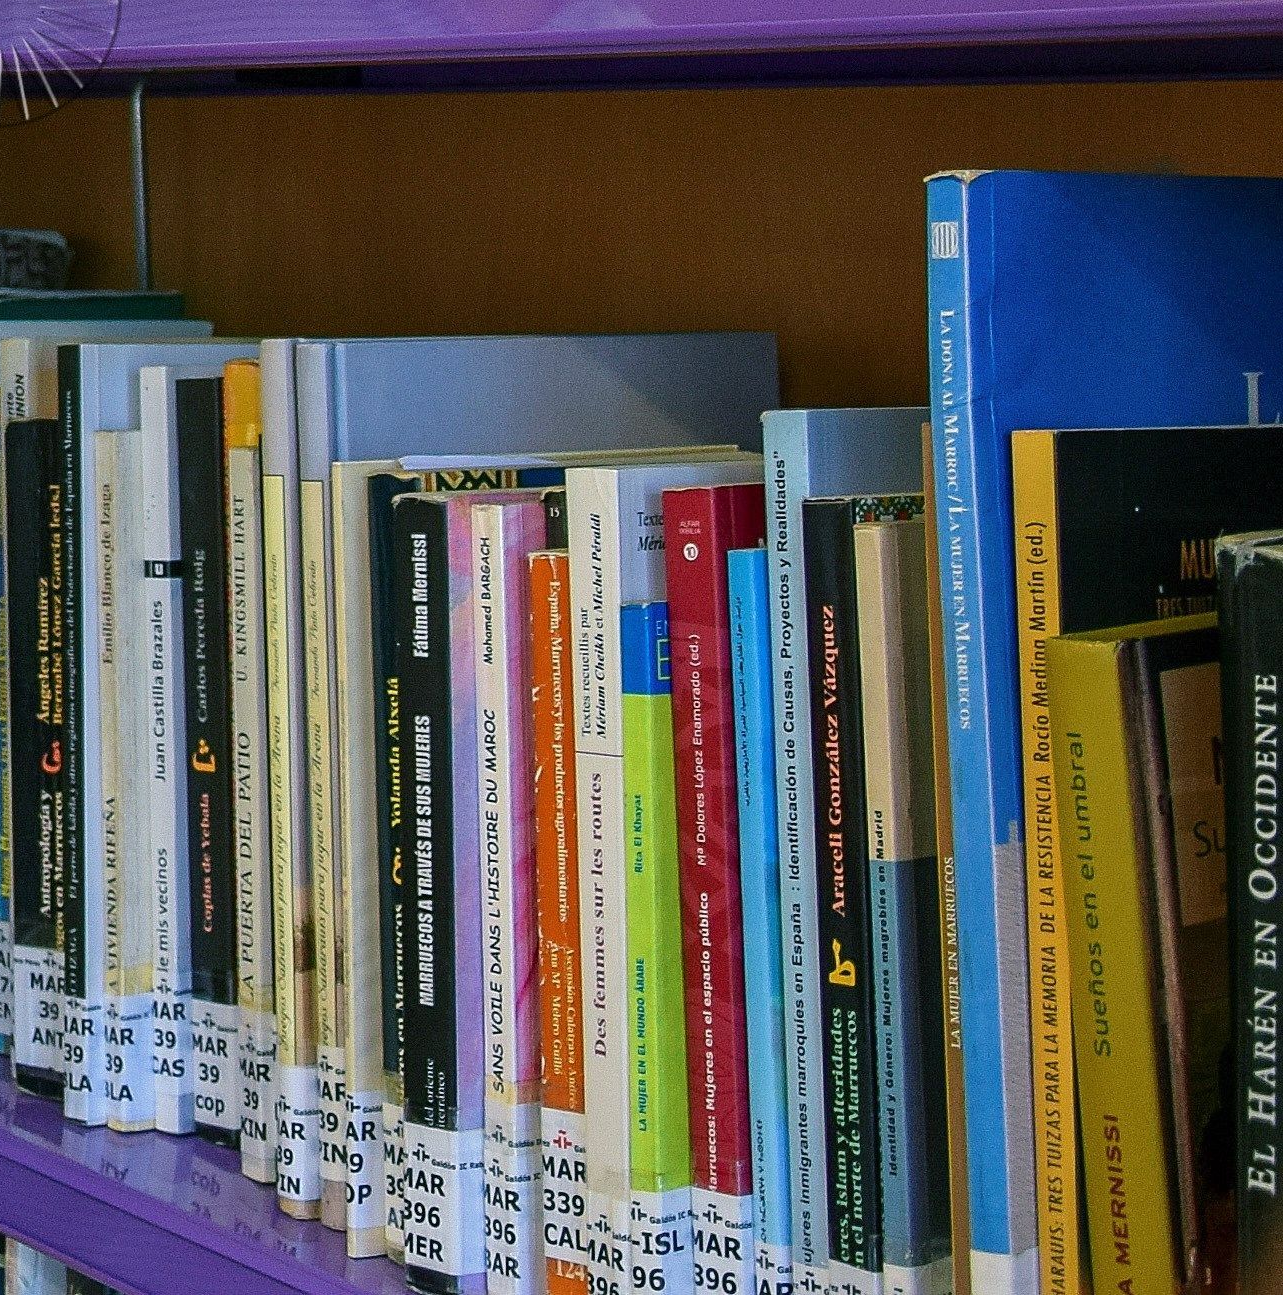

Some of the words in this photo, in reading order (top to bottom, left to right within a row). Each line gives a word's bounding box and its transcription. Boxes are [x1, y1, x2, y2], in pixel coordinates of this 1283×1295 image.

[410, 534, 429, 601] Mernissi
[479, 537, 492, 600] BARGACH
[1026, 521, 1047, 565] (ed.)
[1027, 570, 1047, 631] Martín
[150, 600, 165, 670] Brazales
[411, 606, 430, 658] Fátima
[480, 605, 495, 665] Mohamed
[687, 633, 702, 666] (ed.)
[821, 605, 838, 709] Vázquez
[1032, 639, 1049, 707] Medina
[151, 676, 166, 738] Castilla
[690, 671, 703, 746] Enamorado
[153, 742, 167, 781] Juan
[414, 716, 432, 782] MUJERES
[483, 709, 498, 773] MAROC
[1032, 715, 1051, 762] Rocío
[485, 778, 498, 804] DU
[691, 750, 706, 788] López
[824, 715, 843, 826] González
[1066, 731, 1092, 842] umbral
[1248, 673, 1277, 899] OCCIDENTE
[415, 785, 432, 816] SUS
[588, 773, 604, 840] routes
[695, 793, 706, 843] Dolores
[415, 819, 432, 838] DE
[413, 841, 434, 896] TRAVÉS
[484, 811, 502, 918] L'HISTOIRE
[588, 848, 604, 876] les
[829, 832, 846, 917] Araceli
[1077, 856, 1095, 880] el
[417, 899, 433, 910] A
[592, 885, 605, 919] sur
[1083, 892, 1100, 930] en
[416, 914, 436, 1007] MARRUECOS
[488, 925, 502, 975] DANS
[591, 925, 607, 1010] femmes
[1254, 919, 1277, 968] EN
[489, 983, 504, 1036] VOILE
[1085, 942, 1112, 1057] Sueños
[592, 1018, 607, 1057] Des
[1247, 987, 1278, 1125] HARÉN
[491, 1044, 506, 1094] SANS
[1246, 1143, 1277, 1196] EL
